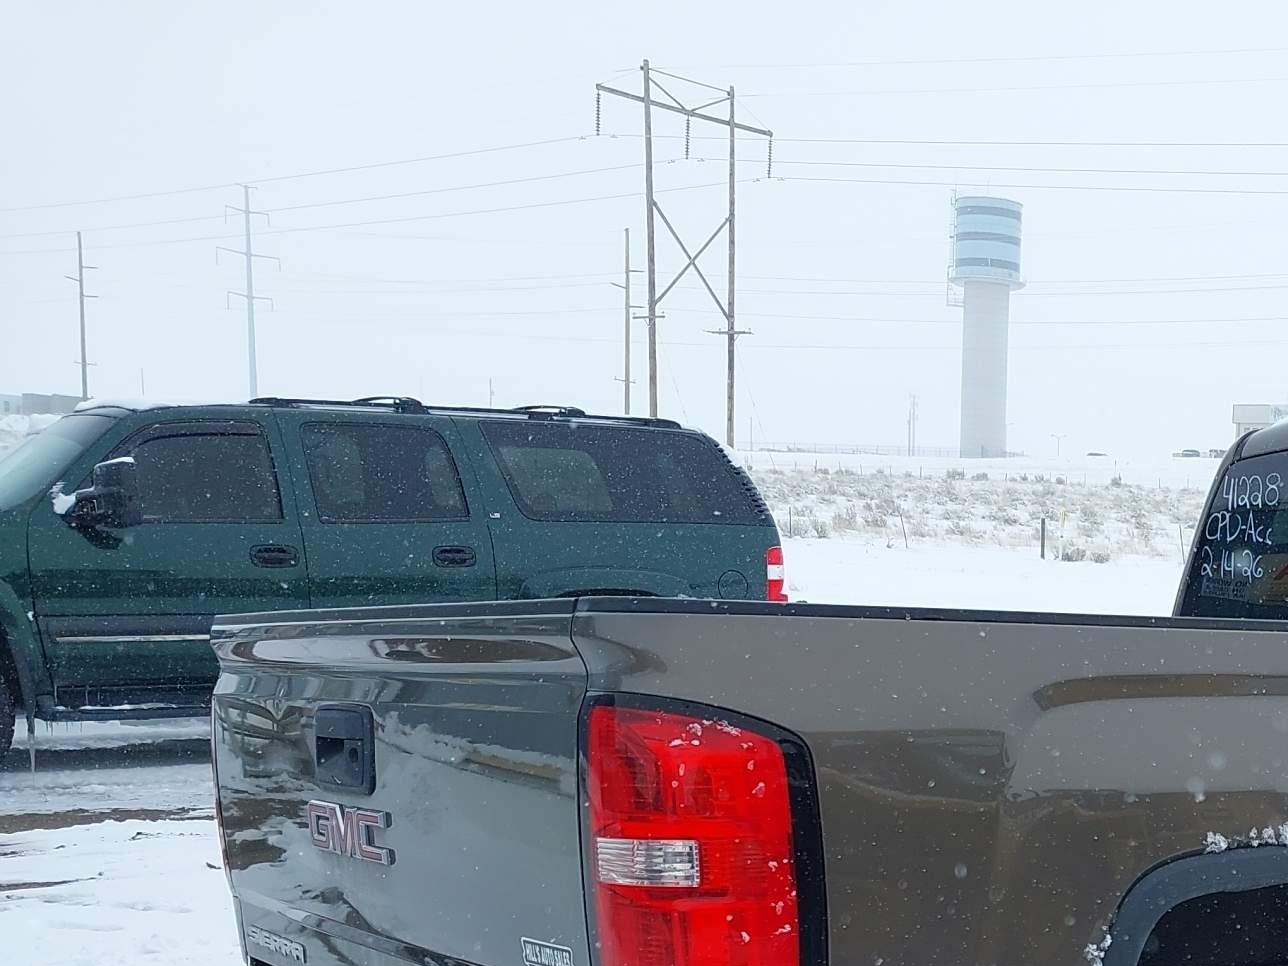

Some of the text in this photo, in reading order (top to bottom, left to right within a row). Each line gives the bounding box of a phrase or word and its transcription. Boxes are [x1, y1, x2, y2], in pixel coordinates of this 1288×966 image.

[1223, 473, 1281, 511] 41228
[308, 799, 396, 866] GMC
[247, 926, 307, 965] SIERRA
